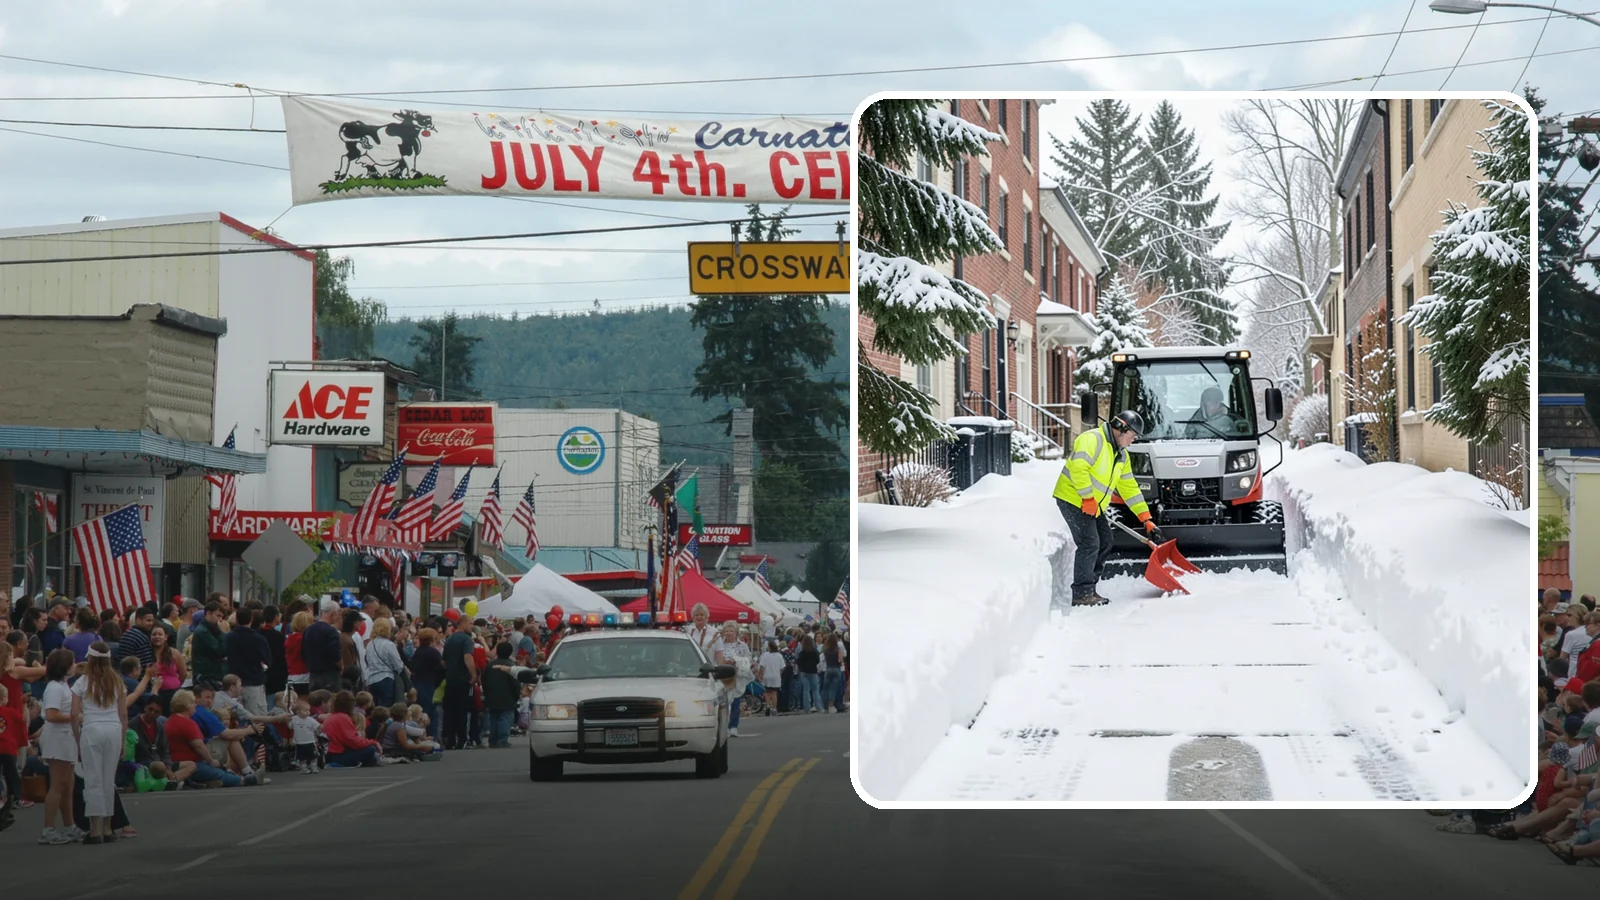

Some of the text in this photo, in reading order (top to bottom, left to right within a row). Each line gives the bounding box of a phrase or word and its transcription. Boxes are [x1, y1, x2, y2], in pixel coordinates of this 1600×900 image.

[481, 141, 604, 192] JULY
[632, 149, 746, 198] 4th.
[696, 254, 850, 280] CROSSWA
[283, 380, 373, 420] ACE
[406, 409, 453, 422] CEDAR
[283, 421, 371, 436] Hardware
[416, 428, 477, 446] Coca-Cola
[353, 467, 387, 480] Simpl
[96, 485, 124, 495] Vincent
[126, 486, 136, 495] de
[138, 486, 155, 495] Paul
[688, 526, 742, 535] CRNATION
[699, 535, 731, 543] GLASS
